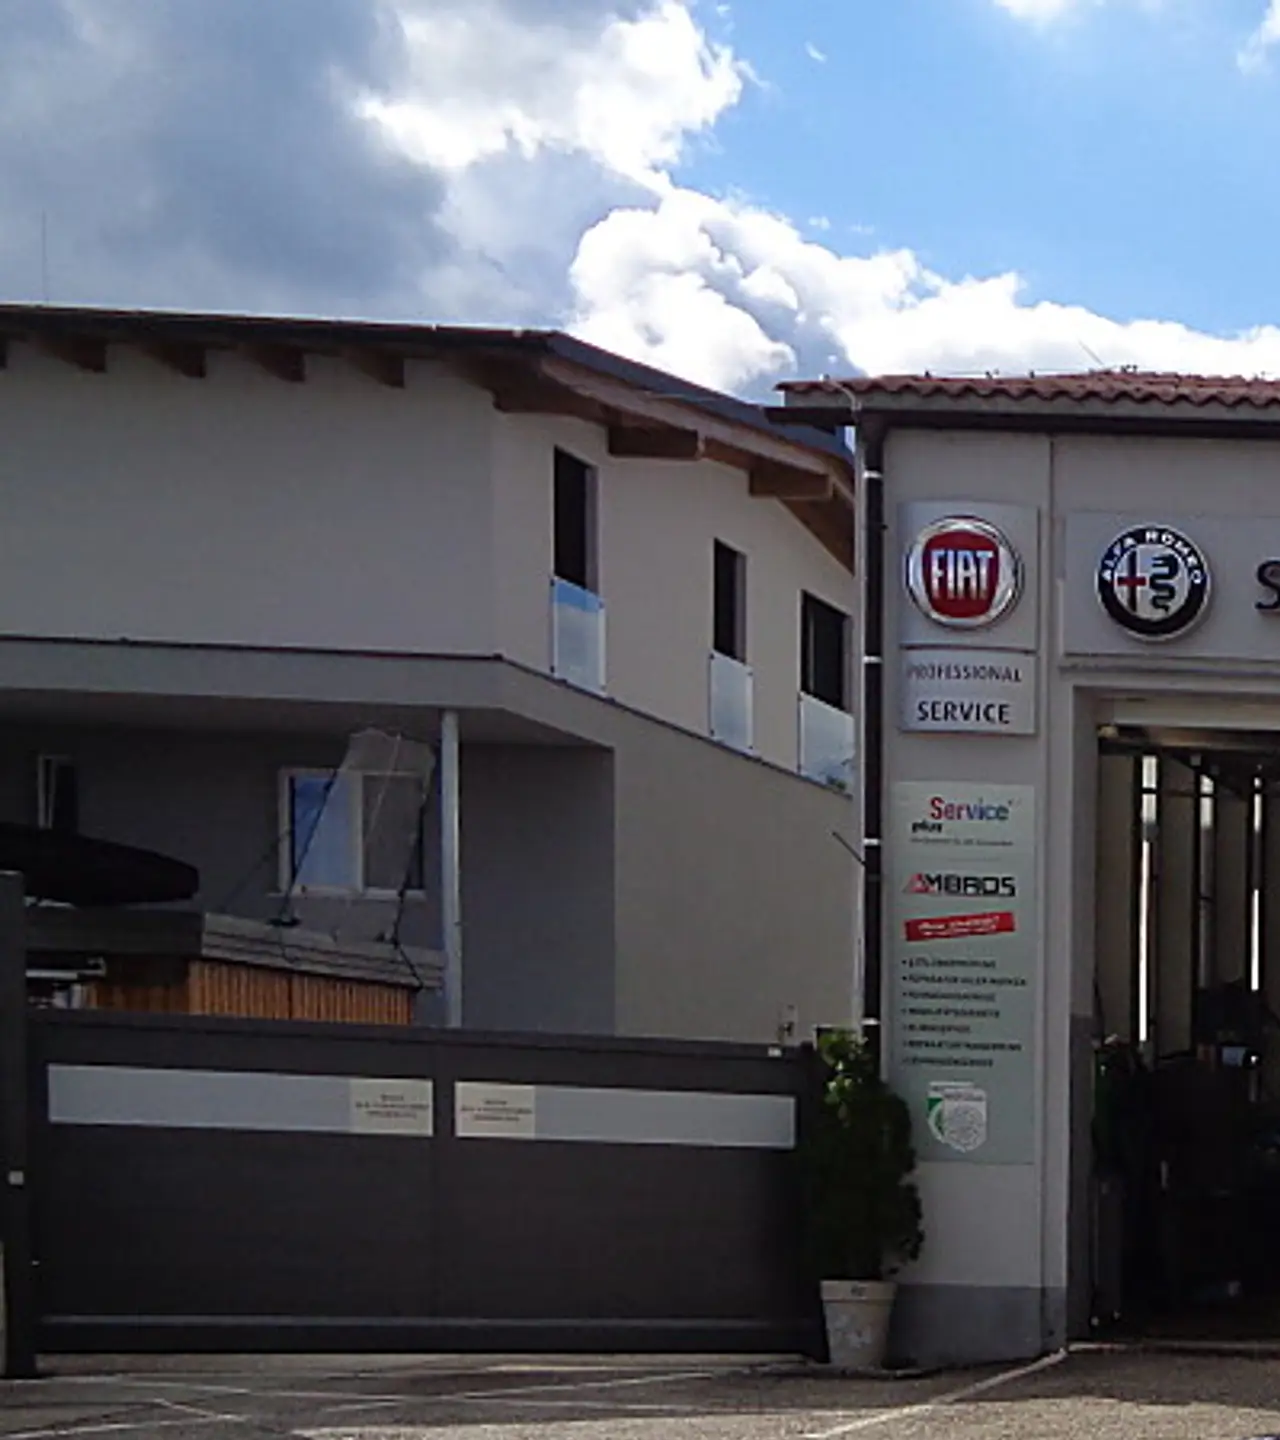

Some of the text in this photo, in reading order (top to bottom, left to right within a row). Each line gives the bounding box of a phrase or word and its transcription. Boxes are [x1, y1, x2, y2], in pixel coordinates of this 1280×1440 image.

[1102, 531, 1203, 585] ALFA ROMEO
[930, 549, 994, 599] FIAT
[908, 665, 1022, 683] PROFESSIONAL
[917, 701, 1010, 724] SERVICE
[930, 796, 1009, 821] Service
[902, 872, 1016, 897] AMBROS
